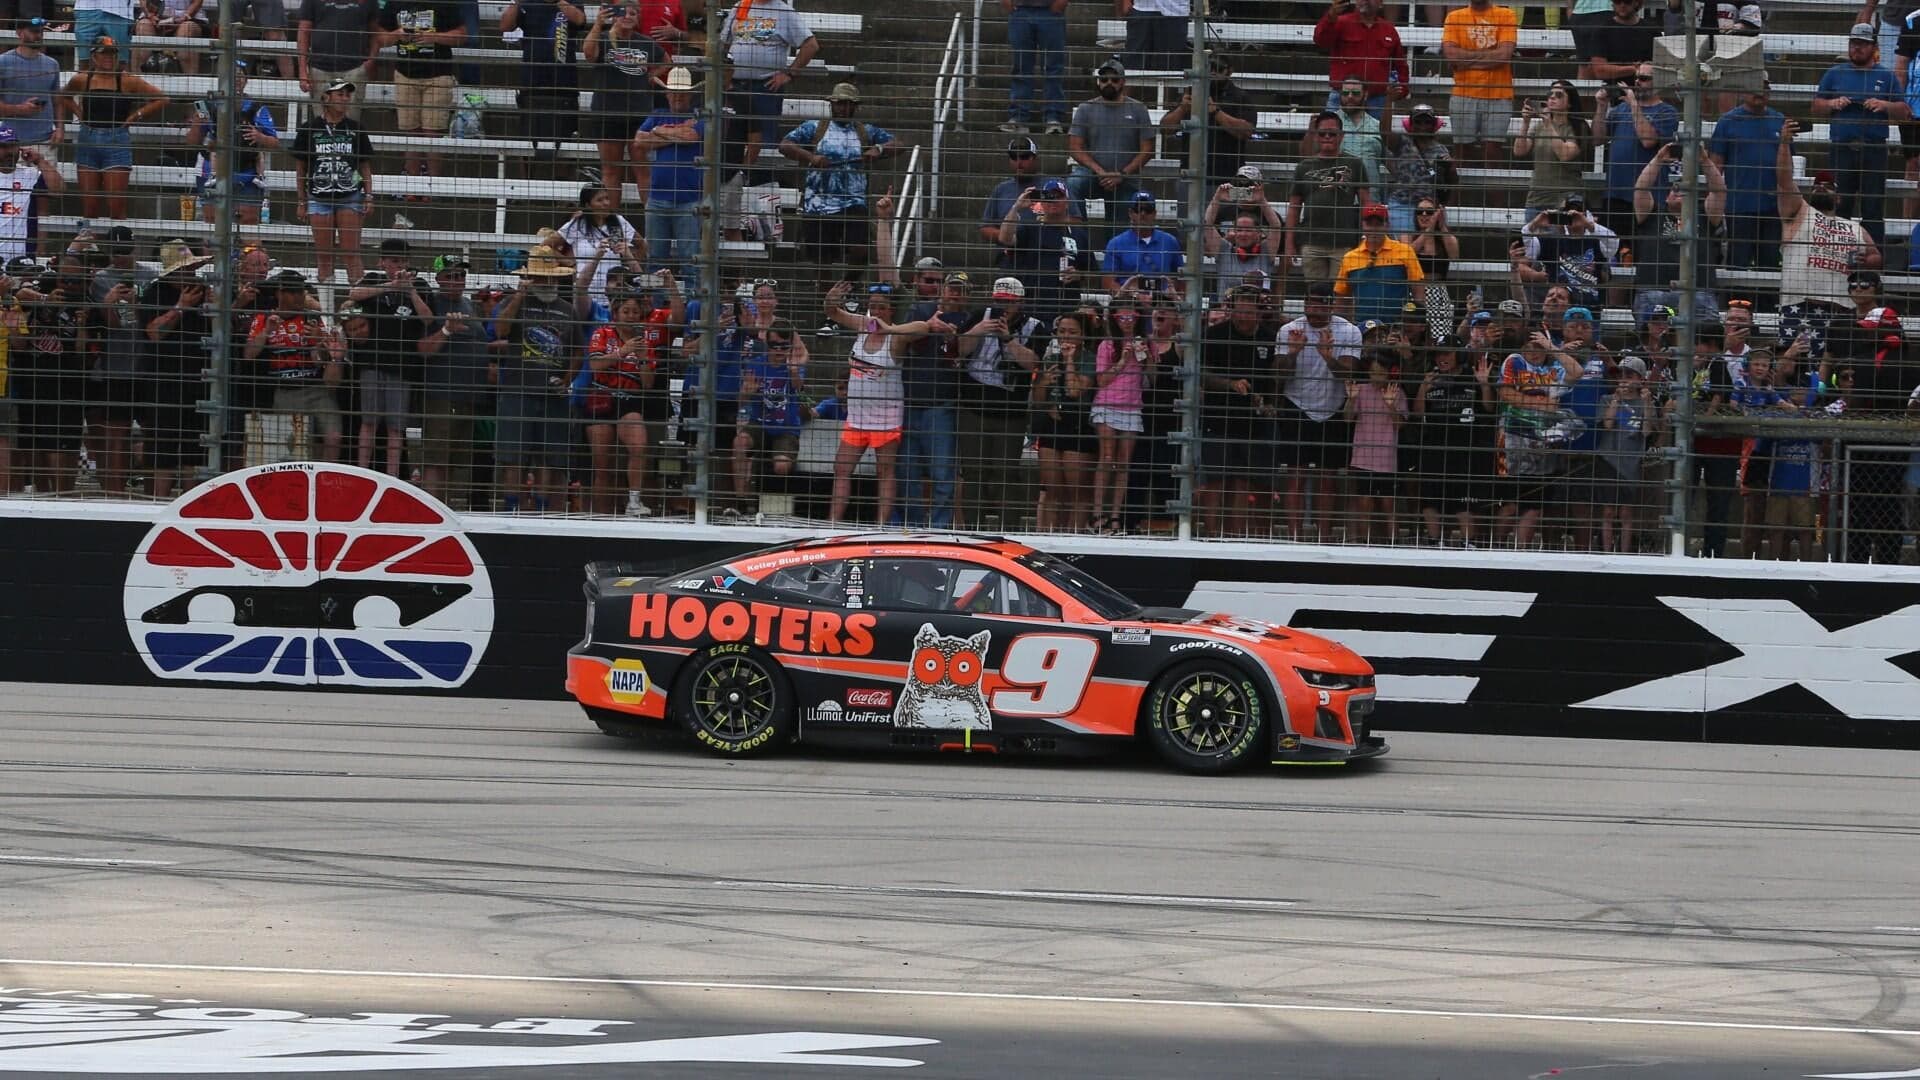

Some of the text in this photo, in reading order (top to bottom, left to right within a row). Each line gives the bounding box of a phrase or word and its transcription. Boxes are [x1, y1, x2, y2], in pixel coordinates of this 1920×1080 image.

[747, 552, 827, 573] Kelley Blue Book
[629, 593, 877, 656] HOOTERS
[710, 643, 750, 657] EAGLE
[1169, 640, 1243, 656] GOODYEAR
[612, 670, 643, 692] NAPA
[991, 634, 1101, 717] 9
[848, 690, 890, 705] Coca-Cola
[1318, 690, 1330, 705] 9
[845, 711, 892, 723] UniFirst
[697, 726, 775, 752] GOODYEAR
[0, 1002, 636, 1036] Froz
